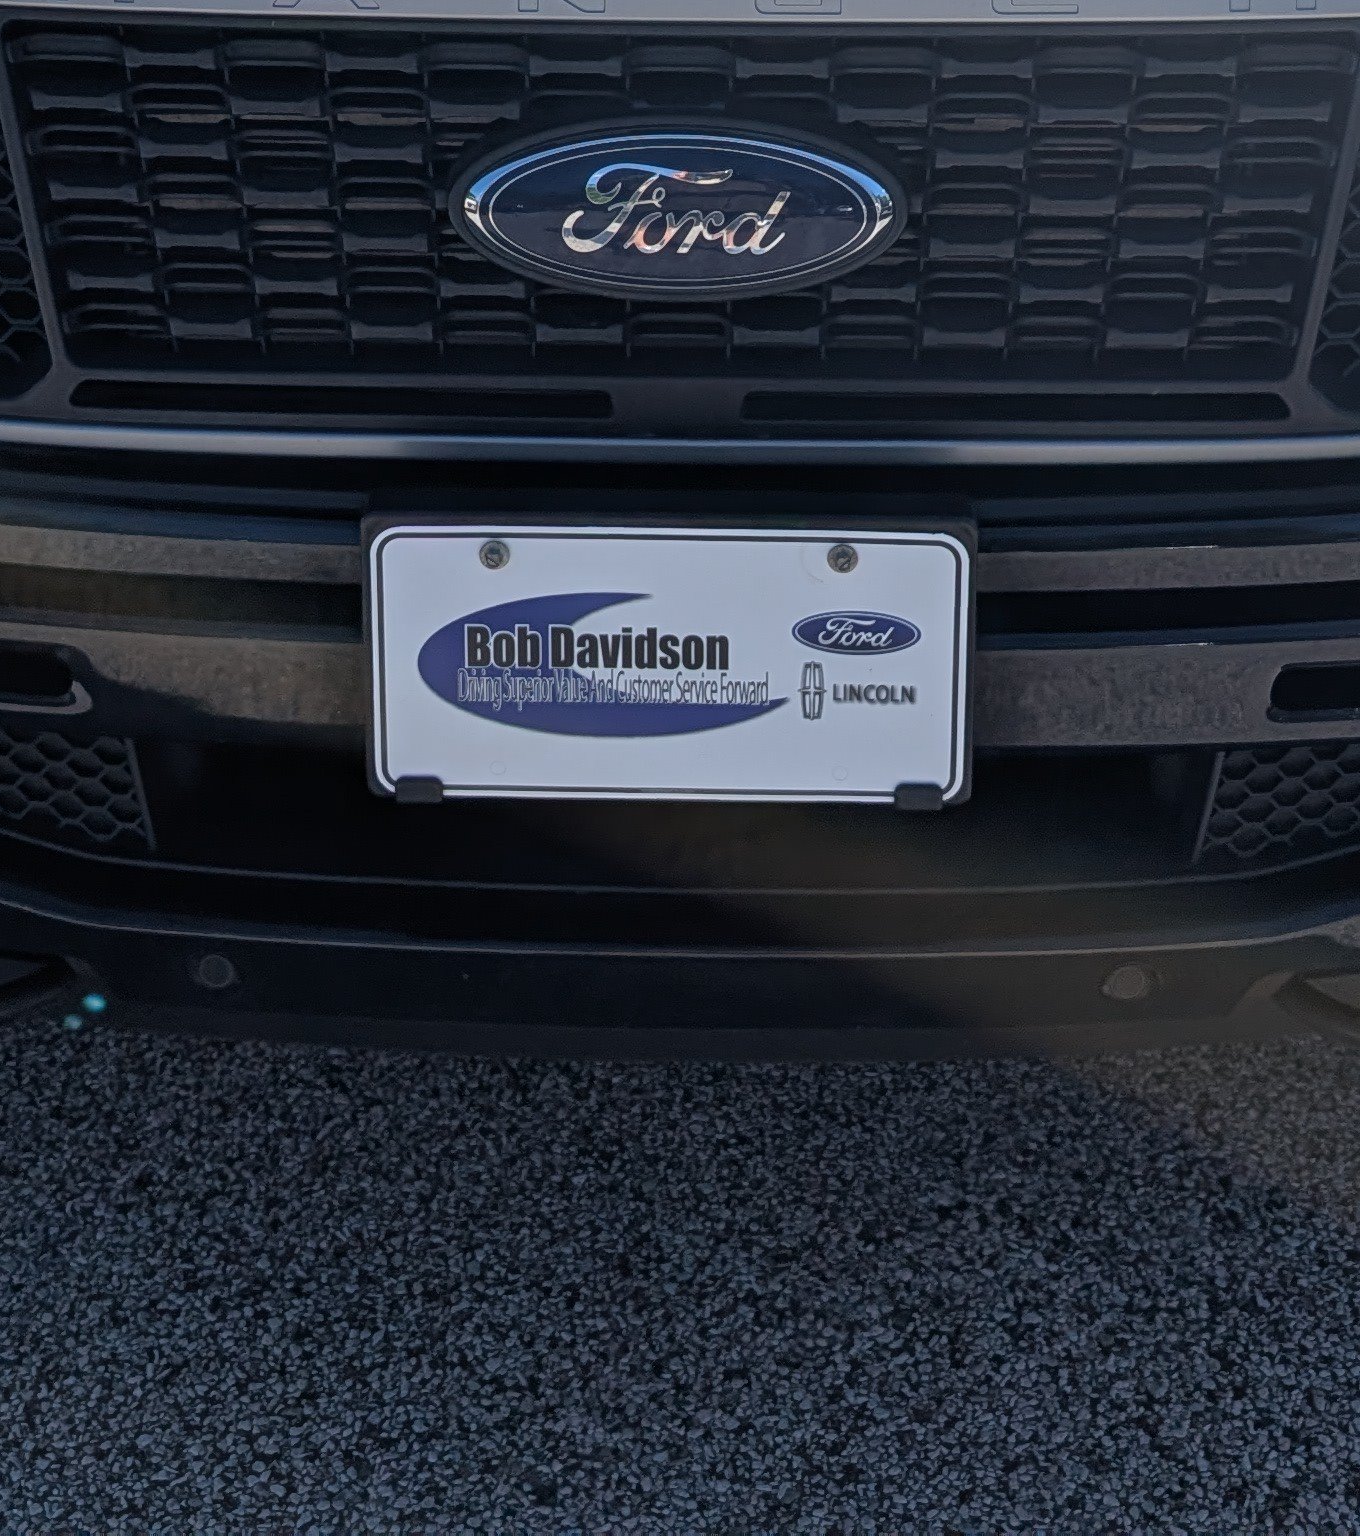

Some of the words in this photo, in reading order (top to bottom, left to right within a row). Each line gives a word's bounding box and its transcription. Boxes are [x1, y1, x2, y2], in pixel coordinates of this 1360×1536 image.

[561, 162, 792, 256] Ford
[466, 625, 541, 668] Bob
[549, 625, 730, 670] Davidson
[818, 617, 895, 647] Ford
[458, 668, 502, 711] Driving
[503, 668, 554, 711] Superior
[553, 668, 589, 703] Value
[590, 669, 615, 703] And
[616, 670, 674, 704] Customer
[675, 671, 718, 704] Service
[720, 671, 769, 705] Forward
[832, 683, 917, 704] LINCOLN
